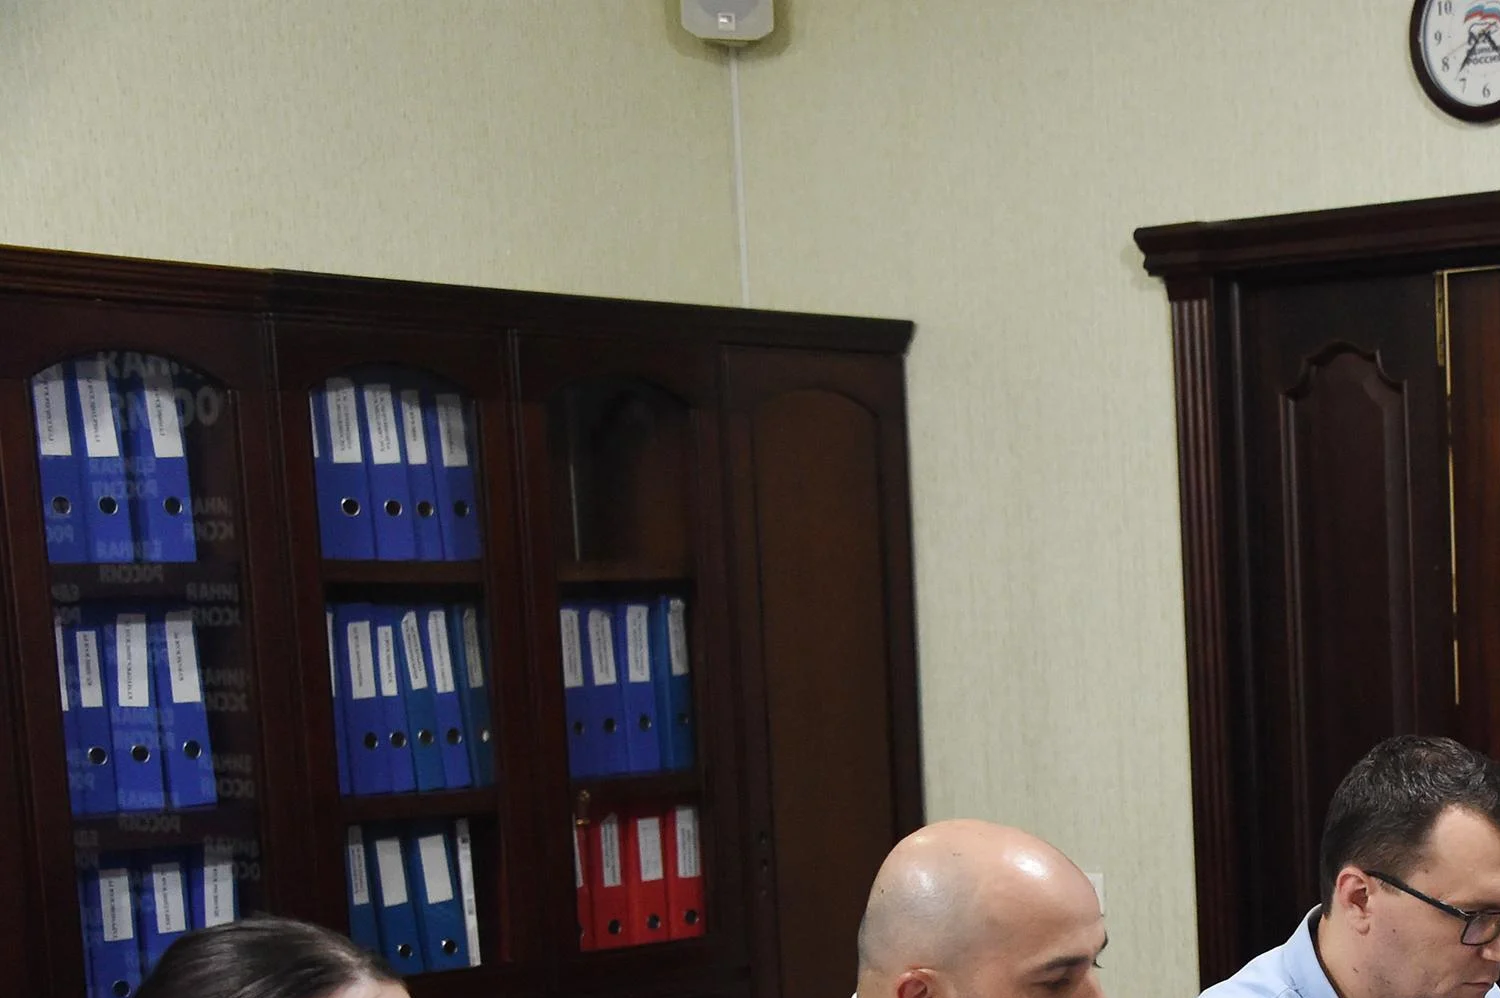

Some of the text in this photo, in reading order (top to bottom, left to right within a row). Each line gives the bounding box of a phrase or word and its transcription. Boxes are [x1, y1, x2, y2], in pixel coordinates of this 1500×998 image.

[1434, 31, 1442, 45] 9
[1441, 56, 1449, 72] 8
[1459, 78, 1467, 93] 7
[1482, 83, 1491, 98] 6
